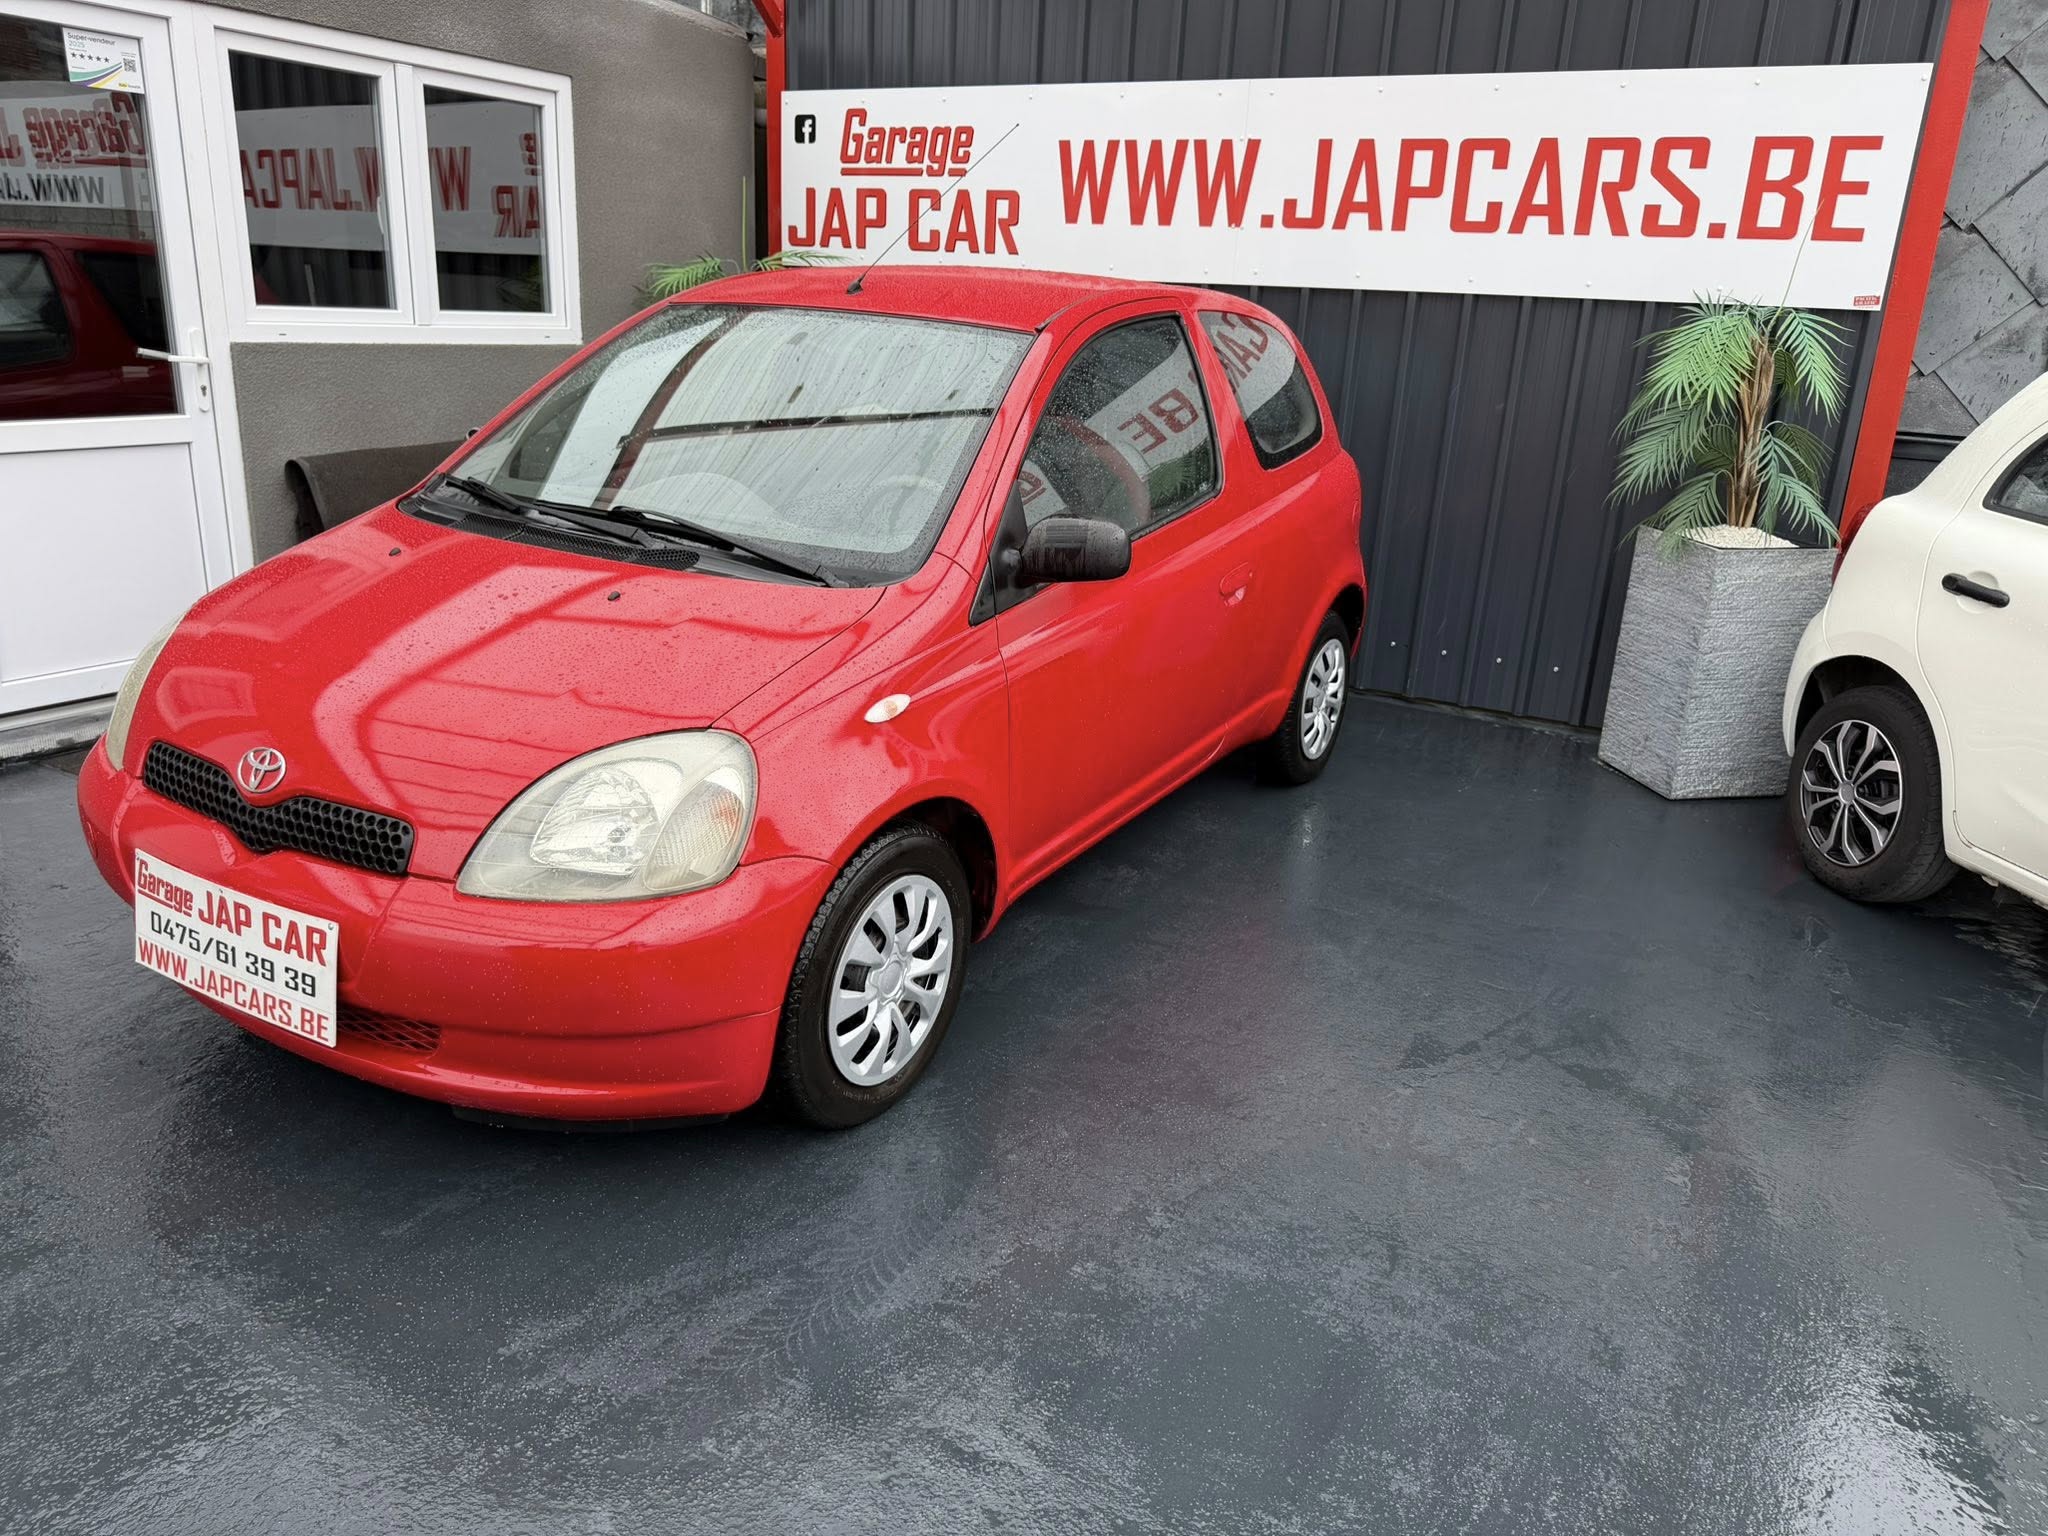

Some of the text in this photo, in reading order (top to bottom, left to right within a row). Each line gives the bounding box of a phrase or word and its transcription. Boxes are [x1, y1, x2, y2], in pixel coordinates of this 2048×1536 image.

[67, 32, 116, 46] Super-vendeur
[840, 108, 974, 177] Garage
[788, 187, 1020, 255] JAP CAR
[1058, 135, 1884, 242] WWW.JAPCARS.BE
[137, 858, 328, 968] Garage JAP CAR
[150, 910, 316, 998] 0475/61 39 39
[138, 936, 329, 1042] WWW.JAPCARS.BE
